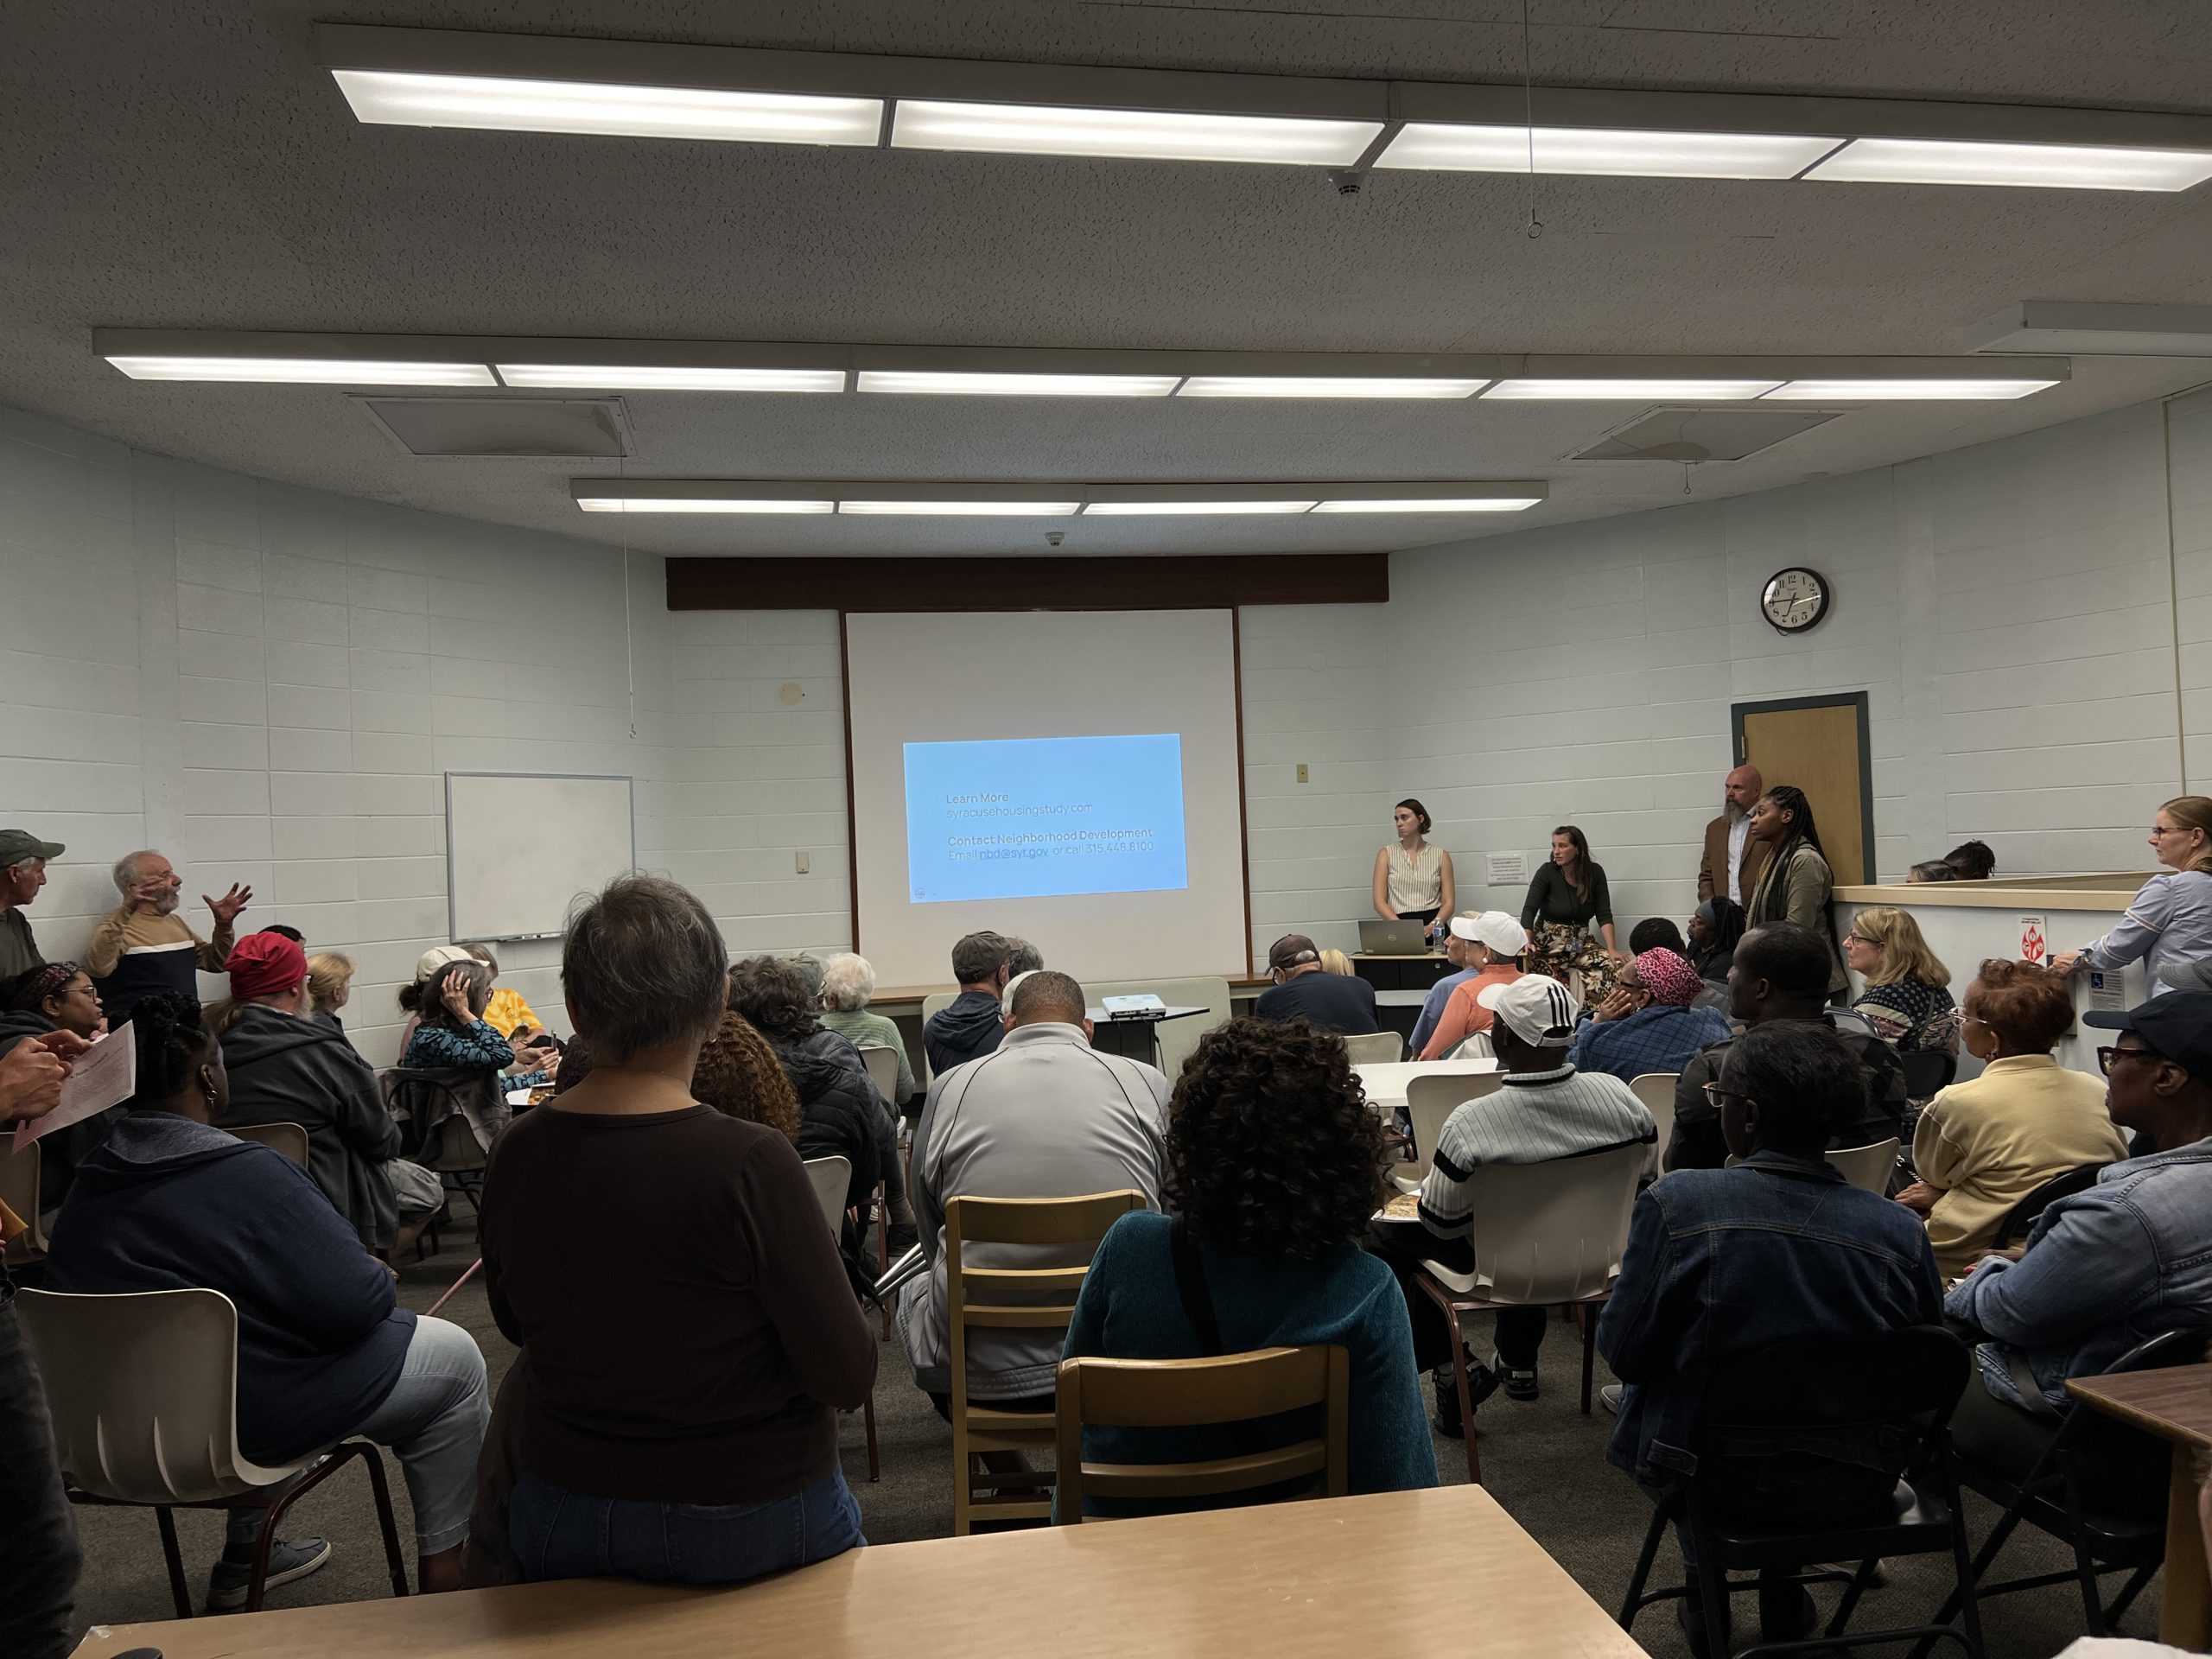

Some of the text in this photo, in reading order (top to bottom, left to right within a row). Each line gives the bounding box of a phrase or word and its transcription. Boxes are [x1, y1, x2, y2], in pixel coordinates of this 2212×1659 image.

[1779, 580, 1785, 588] 11
[1788, 575, 1796, 584] 12
[1802, 576, 1806, 585] 1
[1808, 602, 1815, 612] 4
[1773, 608, 1779, 617] 8
[1802, 612, 1808, 620] 5
[1791, 615, 1797, 624] 6
[946, 792, 1009, 804] Learn More
[946, 804, 1093, 819] syracusehousingstudy.com
[948, 828, 1153, 847] Contact Neighborhood Development
[948, 849, 977, 861] Email
[979, 847, 1049, 860] nbd@syr.gov
[1065, 845, 1084, 855] call
[1086, 841, 1154, 854] 315.448.8100
